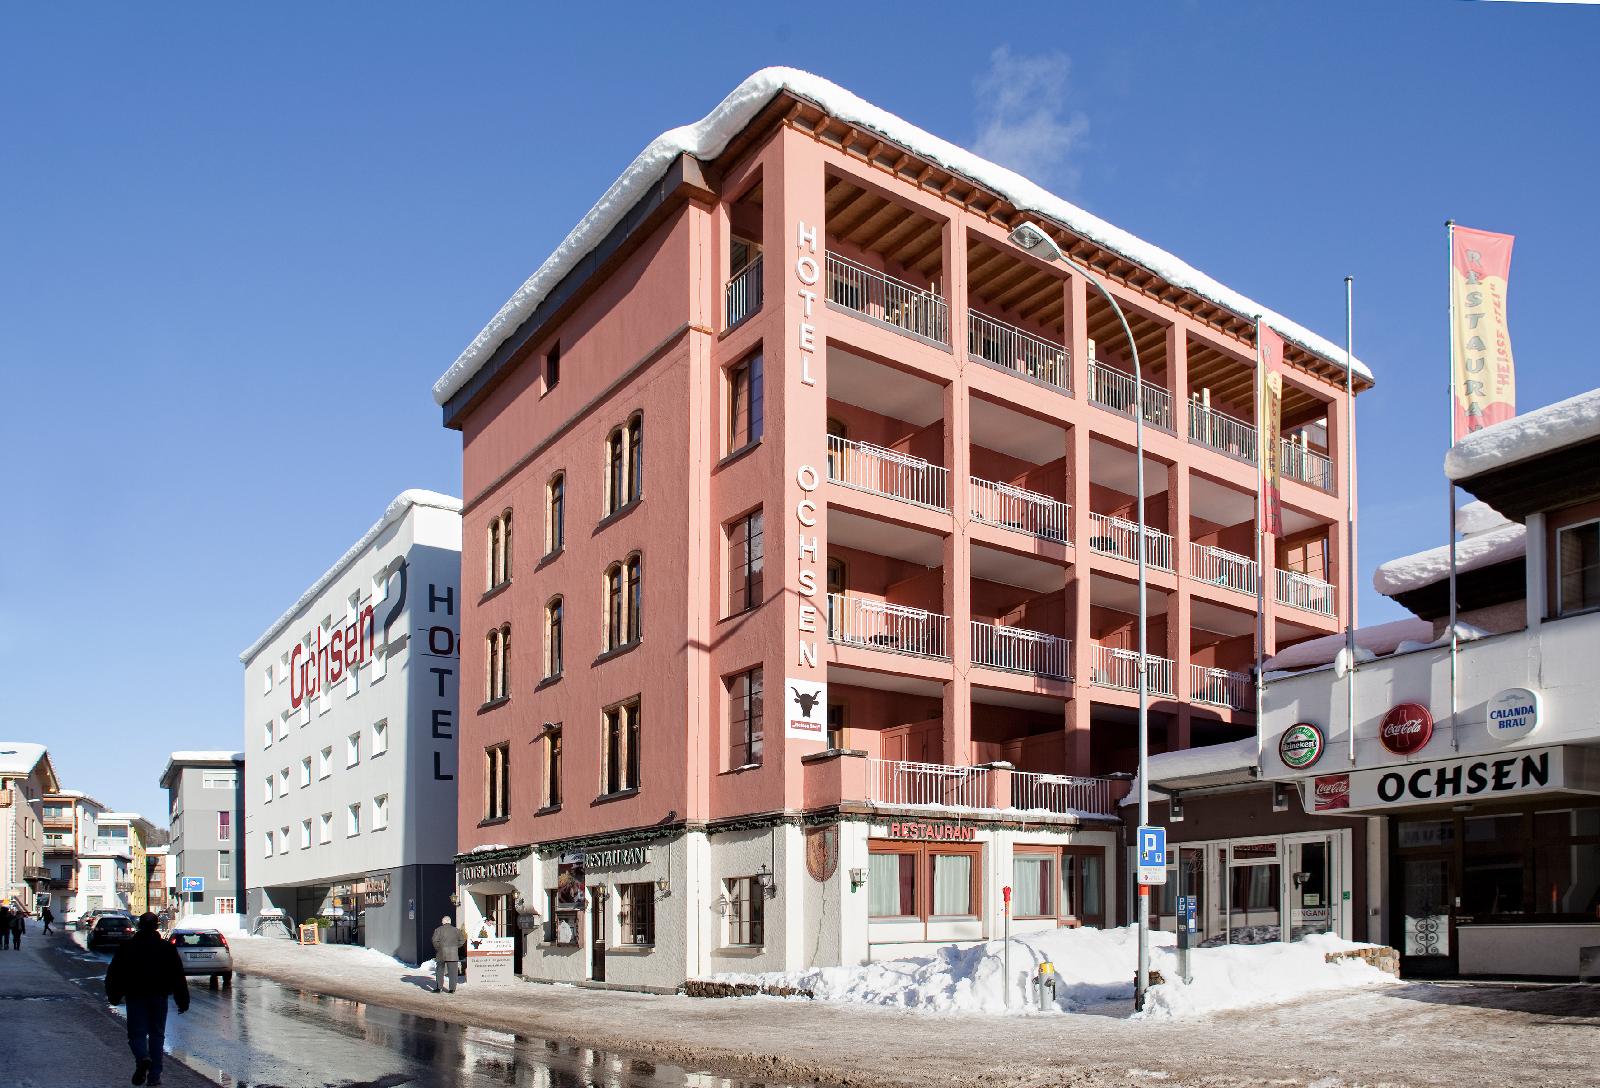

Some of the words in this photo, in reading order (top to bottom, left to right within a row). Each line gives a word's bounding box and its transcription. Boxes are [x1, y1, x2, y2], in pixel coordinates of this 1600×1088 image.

[795, 219, 820, 387] HOTEL
[795, 463, 820, 669] OCHSEN
[290, 604, 375, 710] Ochsen
[428, 582, 455, 781] HOTEL
[1489, 704, 1535, 720] CALANDA
[1377, 752, 1550, 802] OCHSEN
[891, 822, 978, 840] RESTAURANT
[1144, 833, 1157, 861] P
